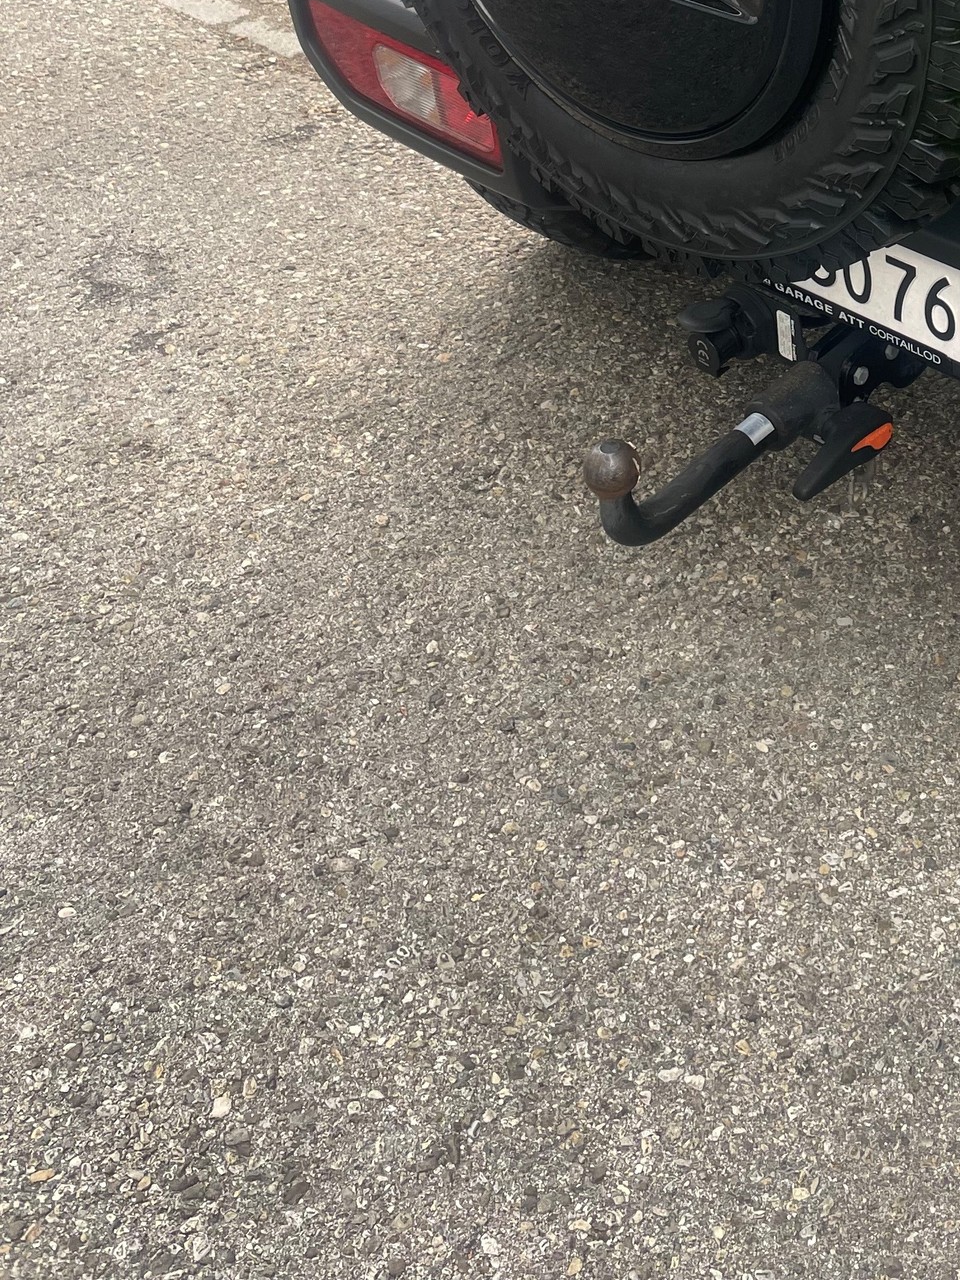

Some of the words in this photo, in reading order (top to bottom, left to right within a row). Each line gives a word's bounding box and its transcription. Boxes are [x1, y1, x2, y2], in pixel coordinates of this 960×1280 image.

[774, 282, 834, 316] GARAGE
[838, 310, 865, 330] ATT
[868, 324, 942, 366] CORTAILLOD
